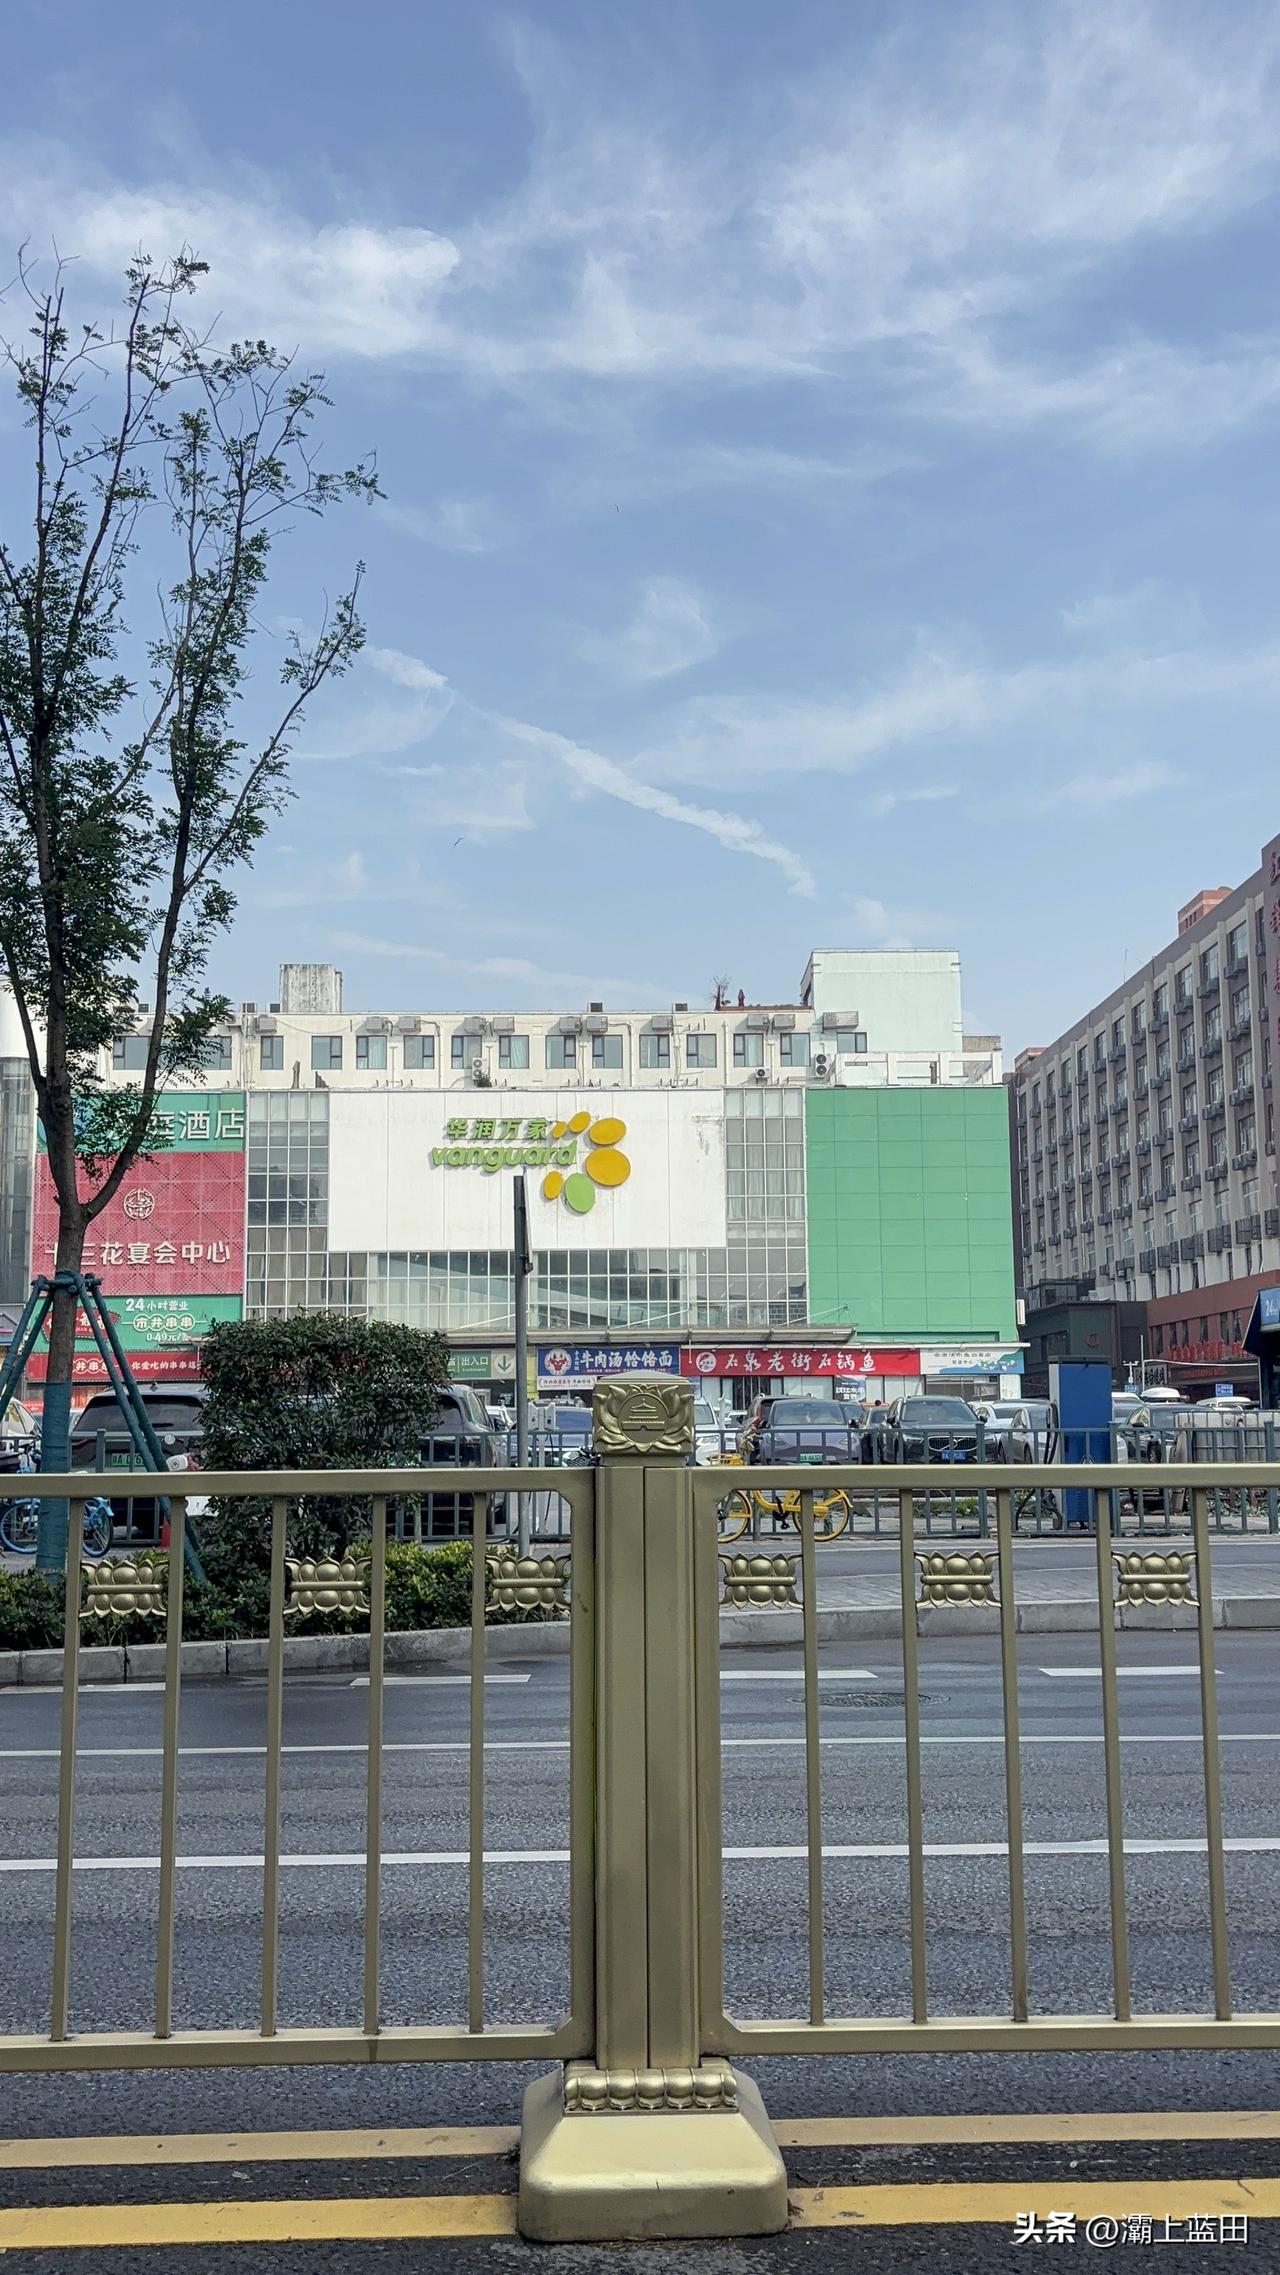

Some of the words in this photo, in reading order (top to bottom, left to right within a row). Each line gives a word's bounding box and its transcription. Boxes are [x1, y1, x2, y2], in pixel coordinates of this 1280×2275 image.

[447, 1117, 547, 1141] 华润万家
[432, 1140, 578, 1173] vanguard
[126, 1298, 189, 1312] 24小时营业
[136, 1316, 193, 1328] 市井串串
[461, 1355, 489, 1366] 出入口
